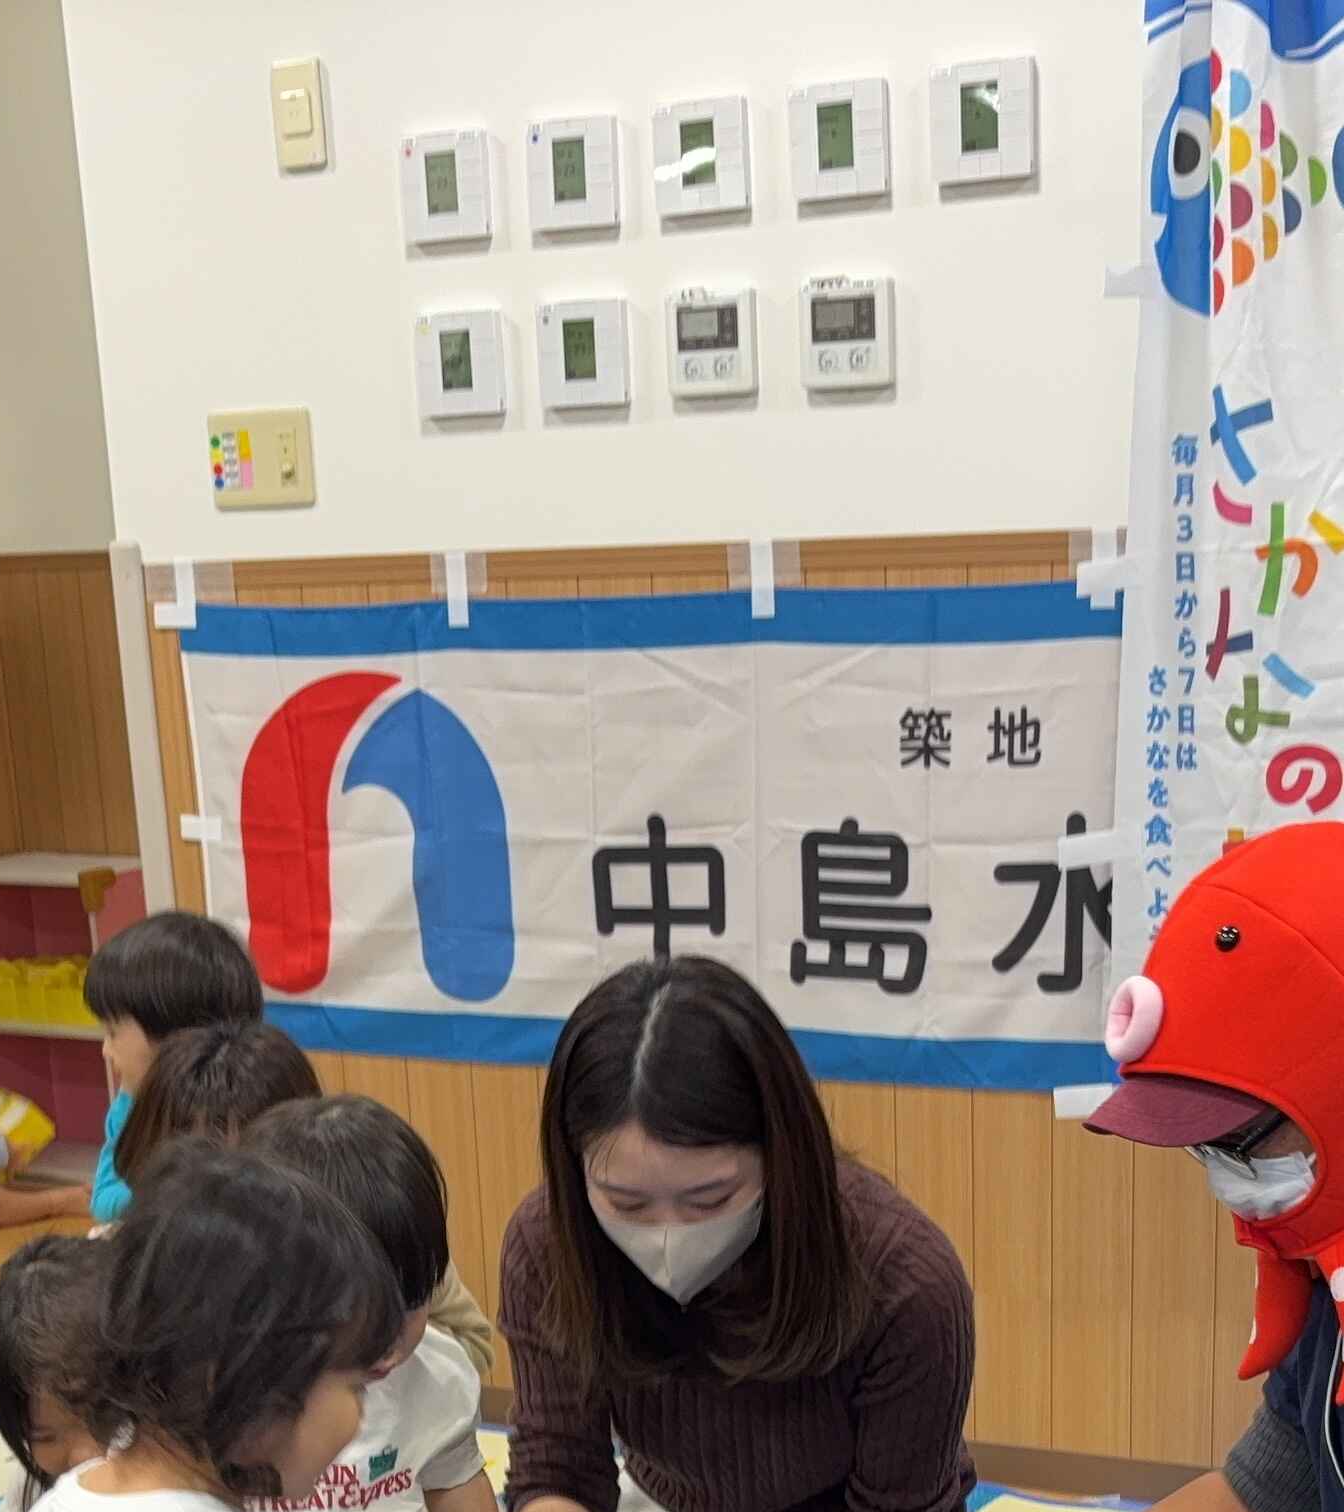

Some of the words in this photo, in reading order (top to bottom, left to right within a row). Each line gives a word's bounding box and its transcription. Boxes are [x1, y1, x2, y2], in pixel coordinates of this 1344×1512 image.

[1170, 433, 1199, 770] 毎月3日から7日は
[899, 704, 1042, 771] 築地
